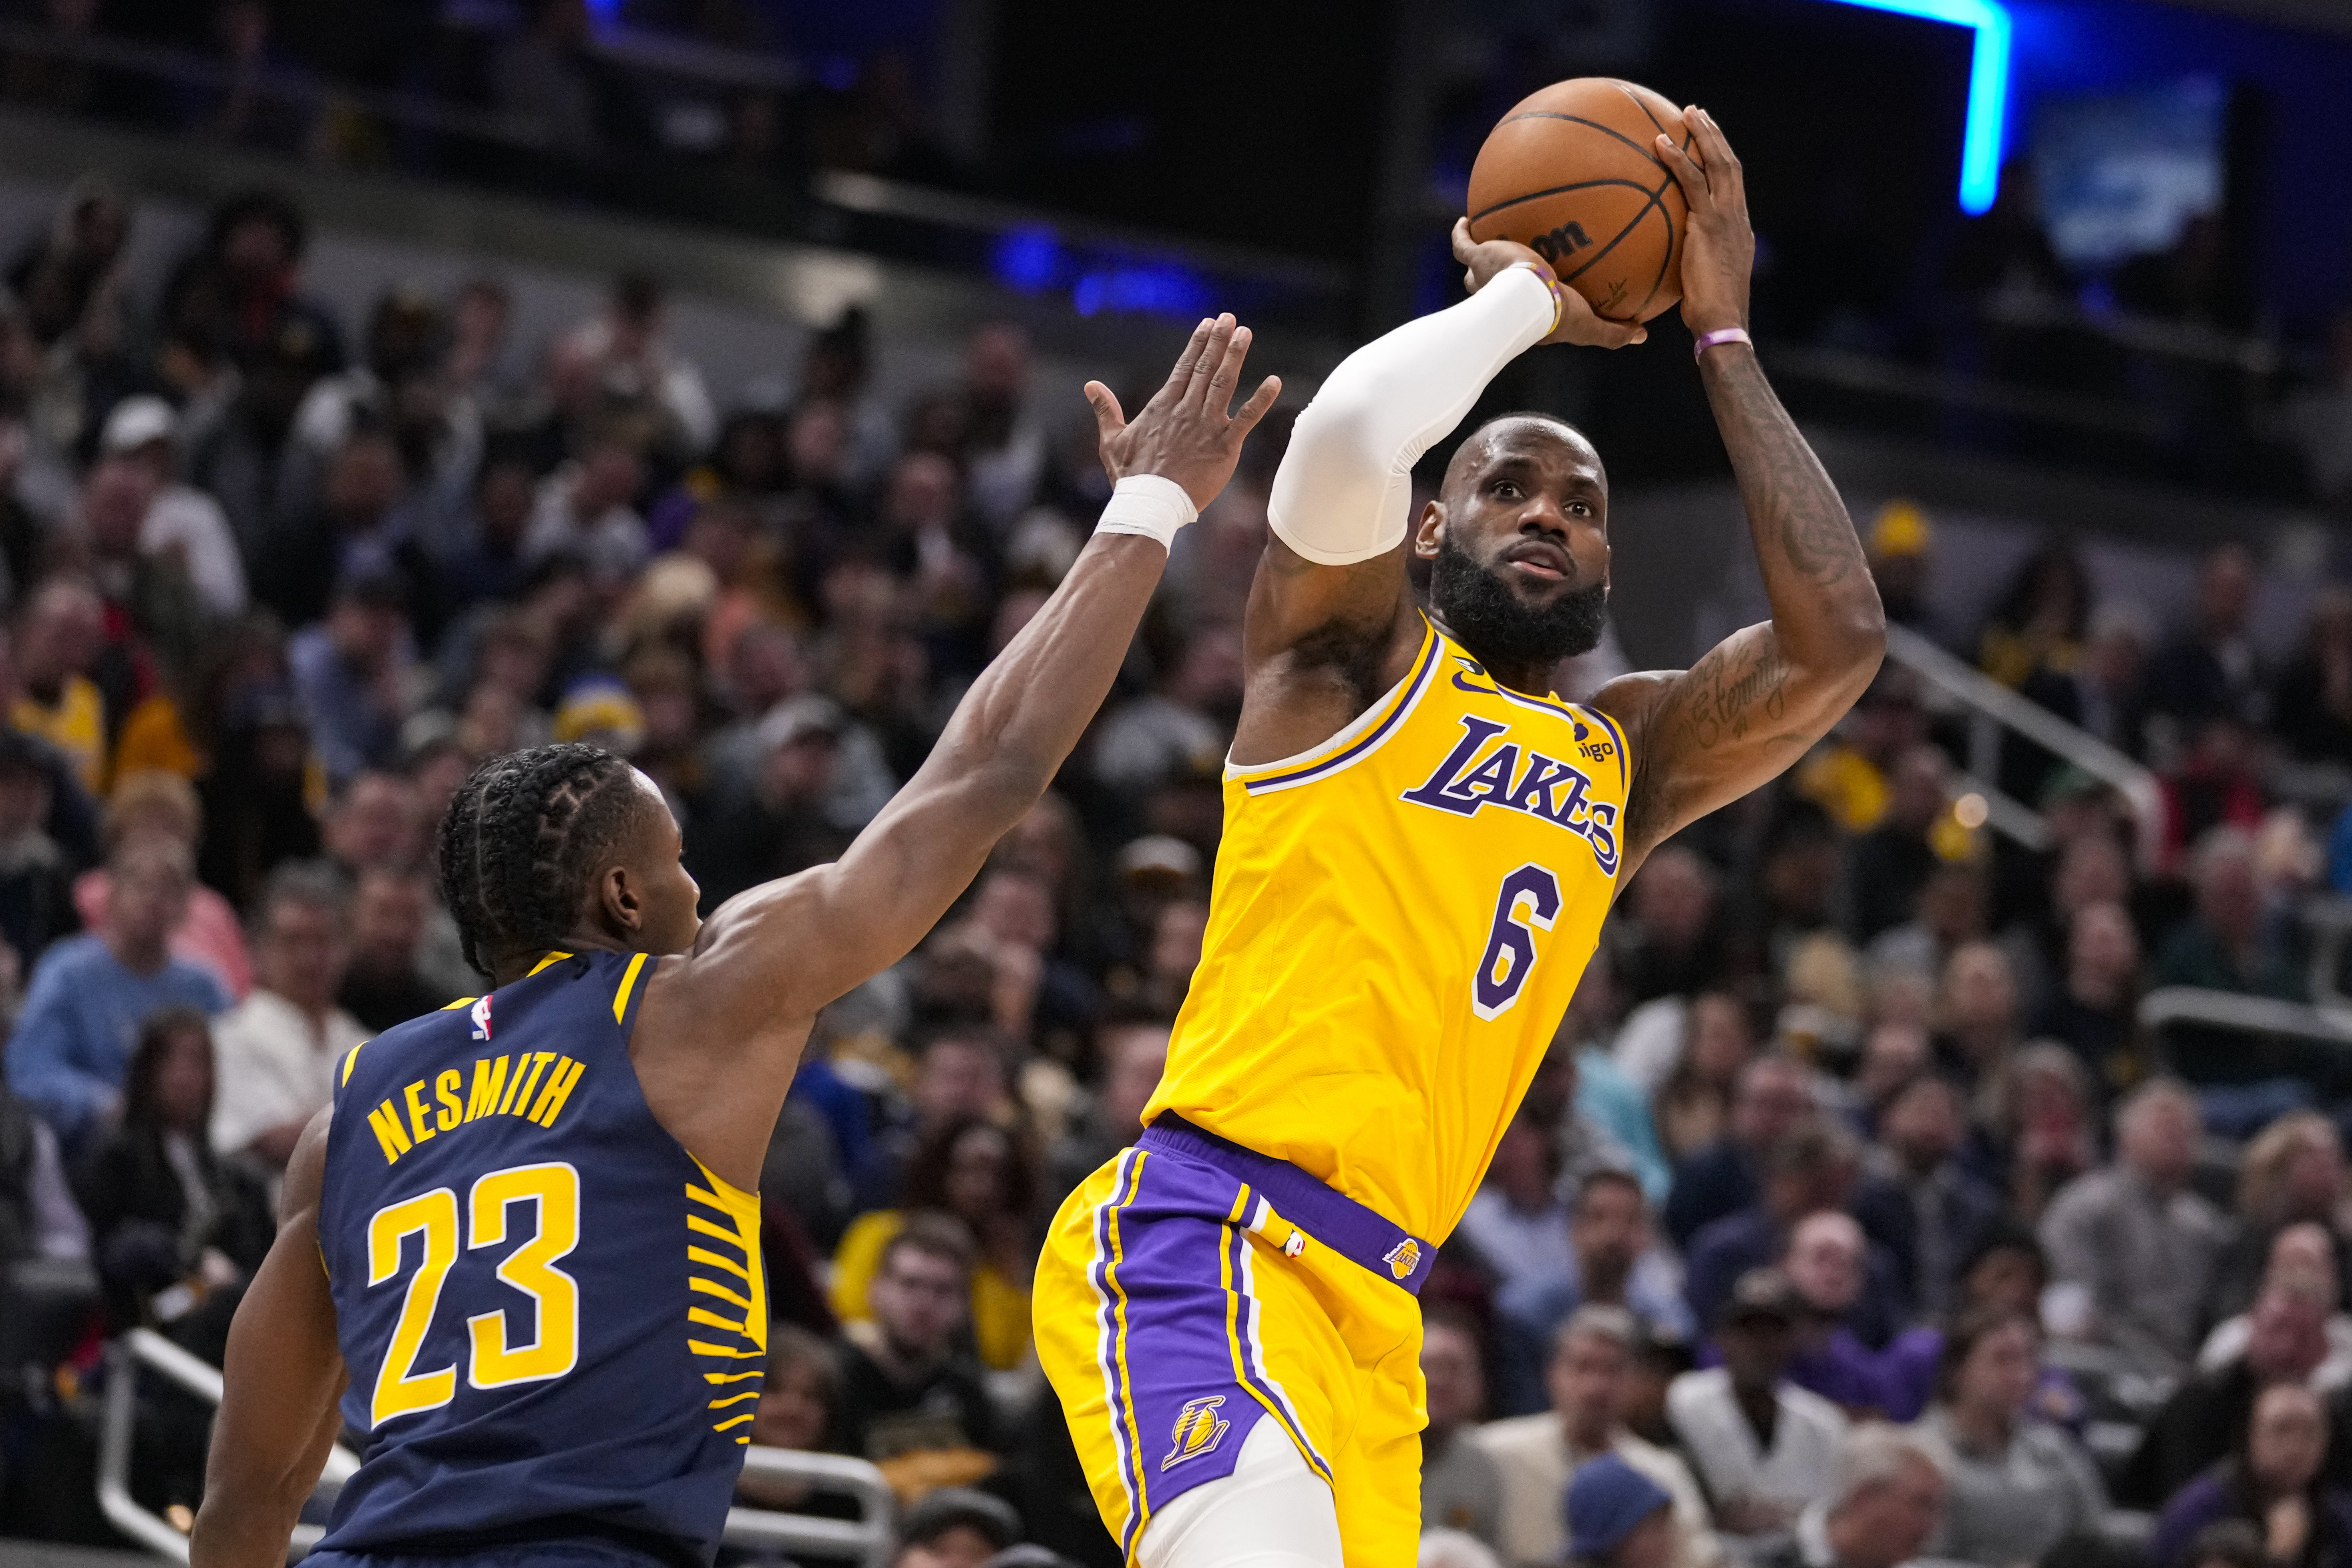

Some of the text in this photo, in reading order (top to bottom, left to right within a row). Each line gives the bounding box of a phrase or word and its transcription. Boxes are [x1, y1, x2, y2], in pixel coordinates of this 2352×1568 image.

[1398, 712, 1619, 878] LAKES
[1578, 743, 1613, 762] igo
[1471, 861, 1563, 1022] 6
[367, 1051, 586, 1165] NESMITH
[368, 1161, 580, 1430] 23
